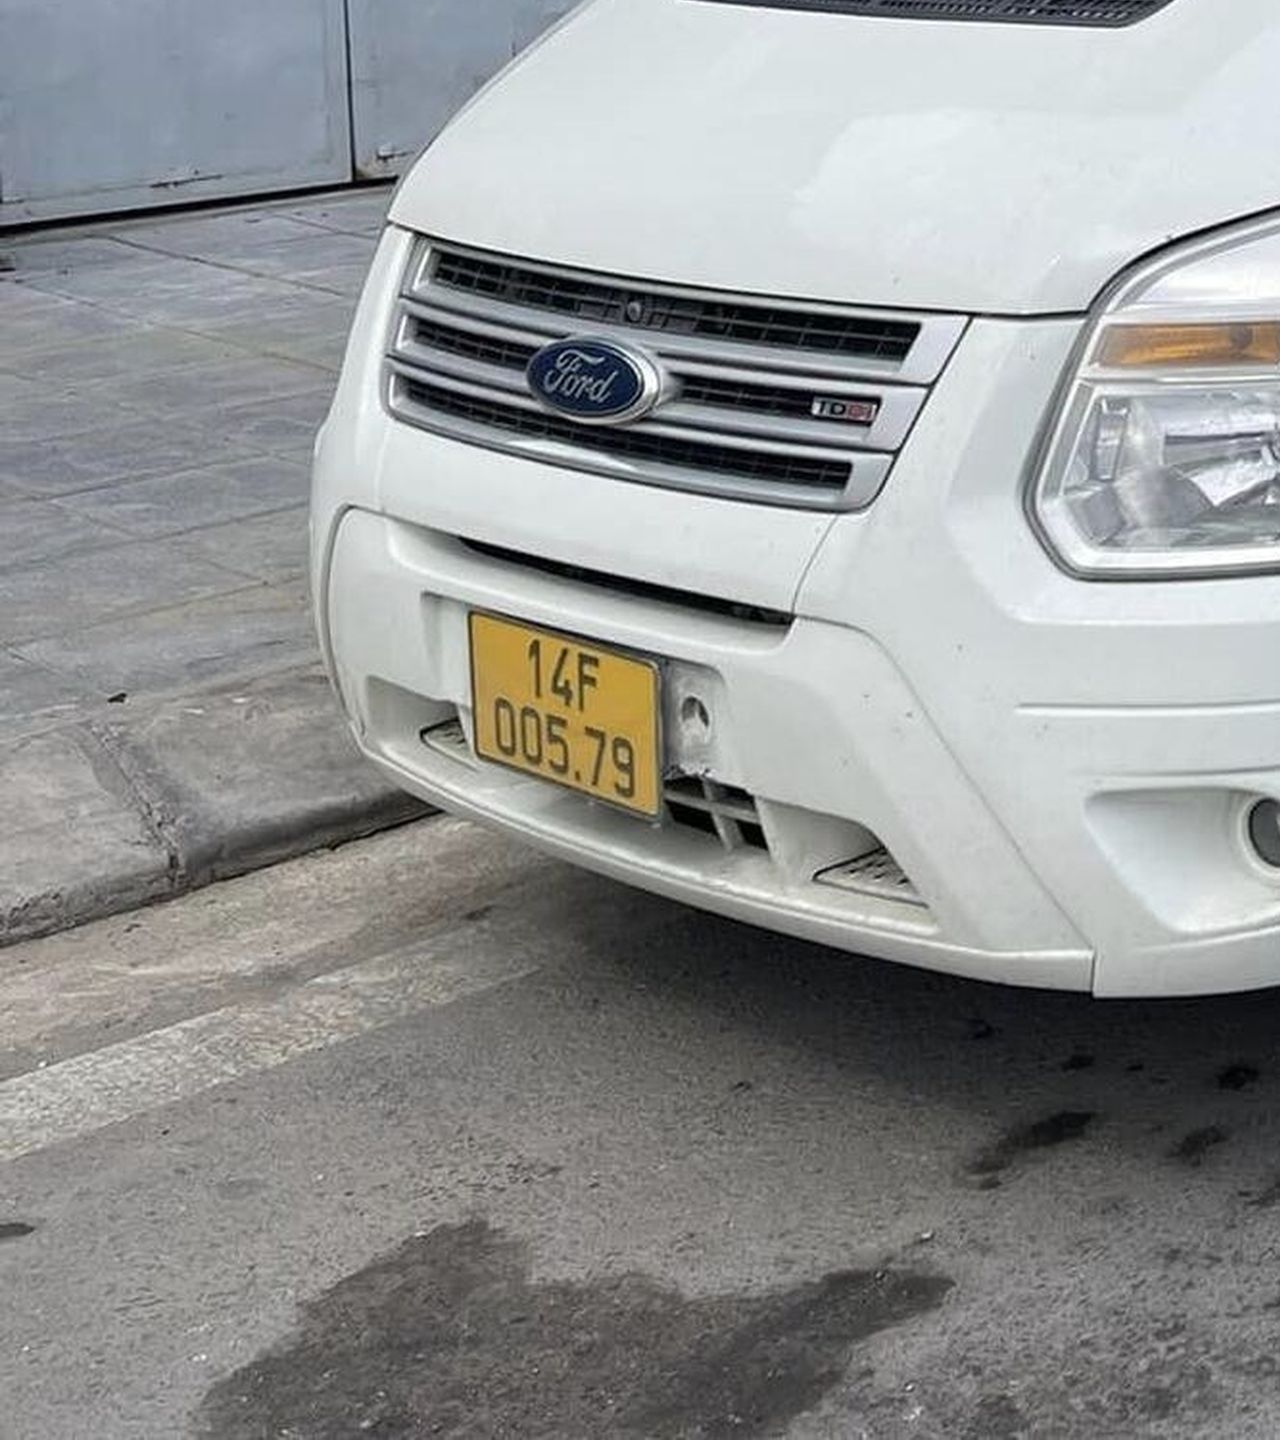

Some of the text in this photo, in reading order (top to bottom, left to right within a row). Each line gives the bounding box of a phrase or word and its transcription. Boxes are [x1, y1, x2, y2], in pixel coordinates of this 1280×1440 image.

[547, 349, 614, 403] Ford
[529, 639, 599, 713] 14F
[495, 697, 635, 797] 005.79
